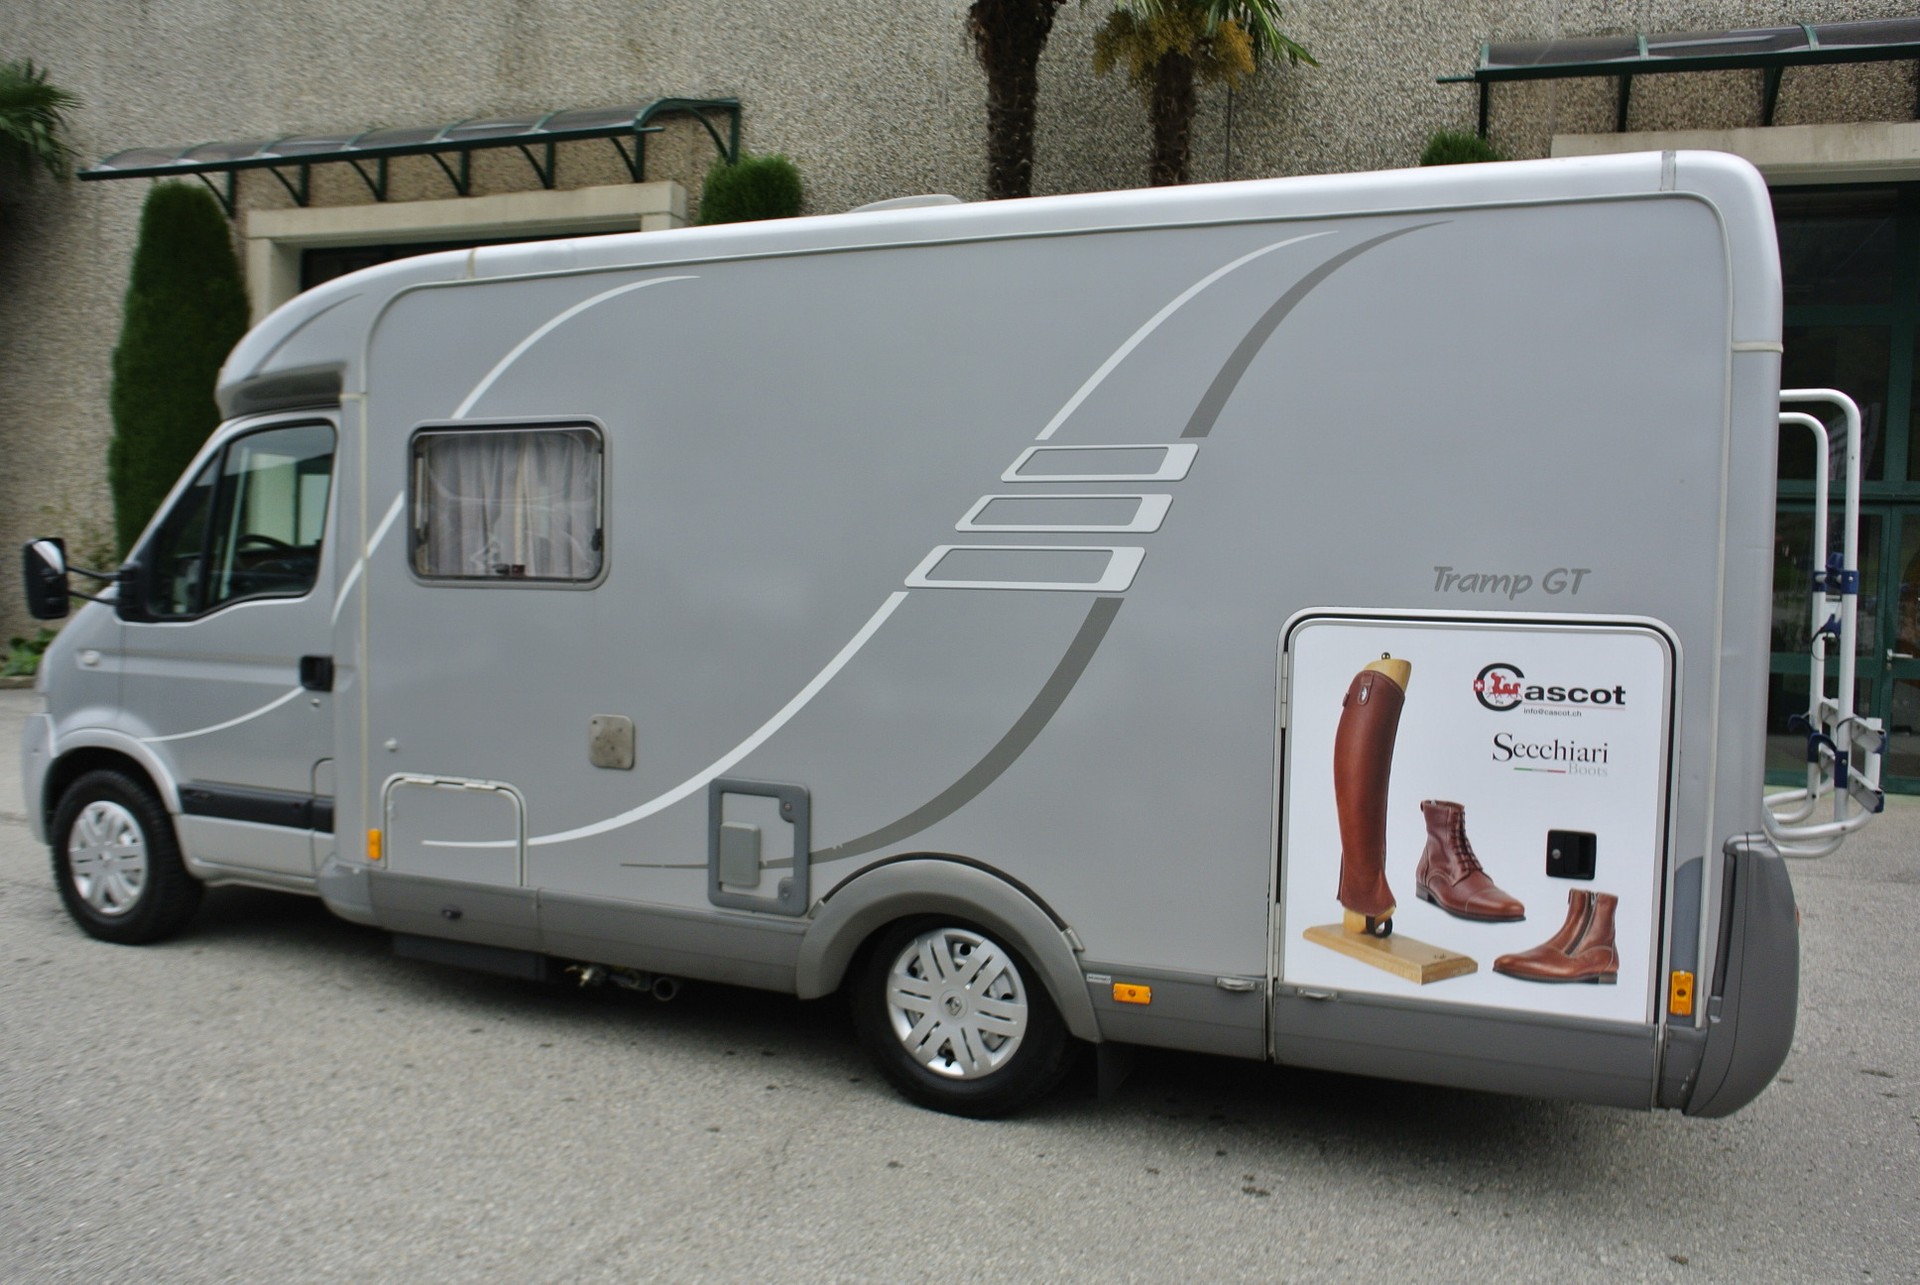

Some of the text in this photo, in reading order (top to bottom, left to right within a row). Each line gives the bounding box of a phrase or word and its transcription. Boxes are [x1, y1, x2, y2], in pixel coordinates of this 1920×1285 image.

[1433, 566, 1592, 601] Tramp GT
[1476, 662, 1626, 712] Cascot
[1523, 708, 1582, 718] info@cascot.ch
[1492, 732, 1608, 764] Secchiari
[1568, 762, 1608, 777] Boots
